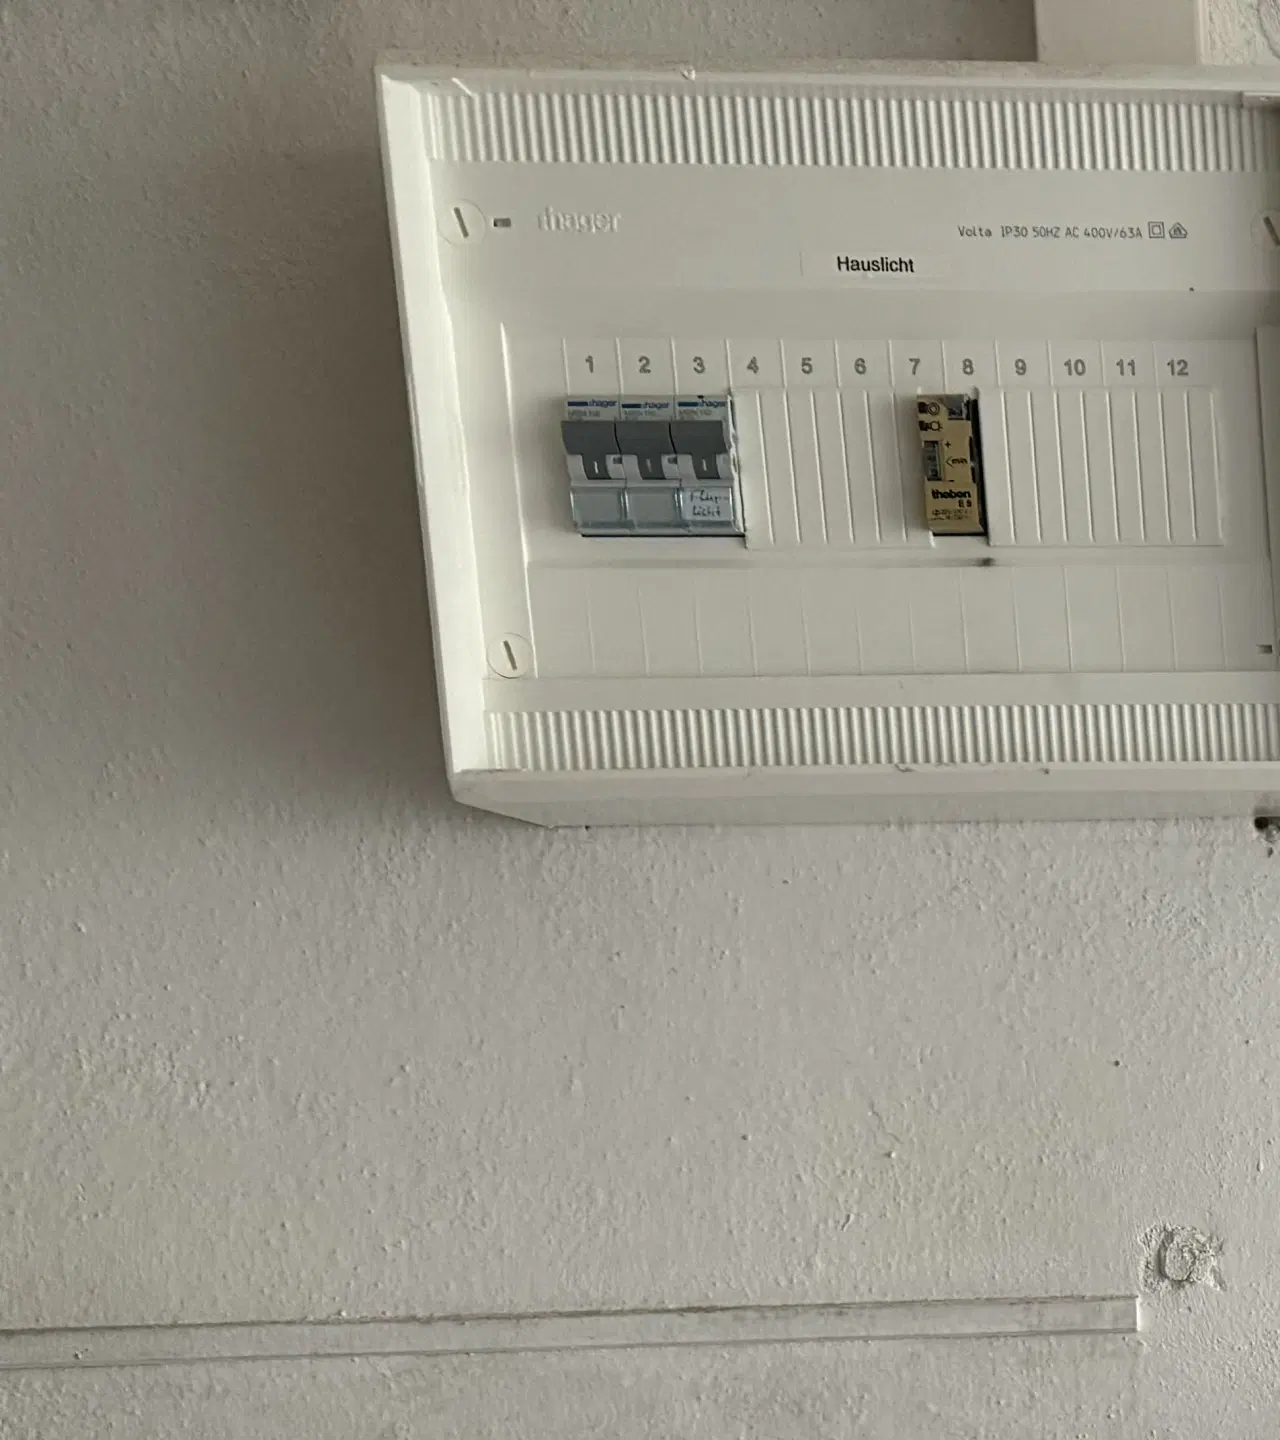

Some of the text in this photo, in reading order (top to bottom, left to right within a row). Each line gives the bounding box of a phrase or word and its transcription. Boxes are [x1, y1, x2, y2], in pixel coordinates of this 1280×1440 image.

[957, 225, 1143, 239] Volta IP30 50HZ AC 400V/63A
[837, 256, 914, 273] Hauslicht
[585, 355, 1188, 376] 1 2 3 4 5 6 7 8 9 10 11 12
